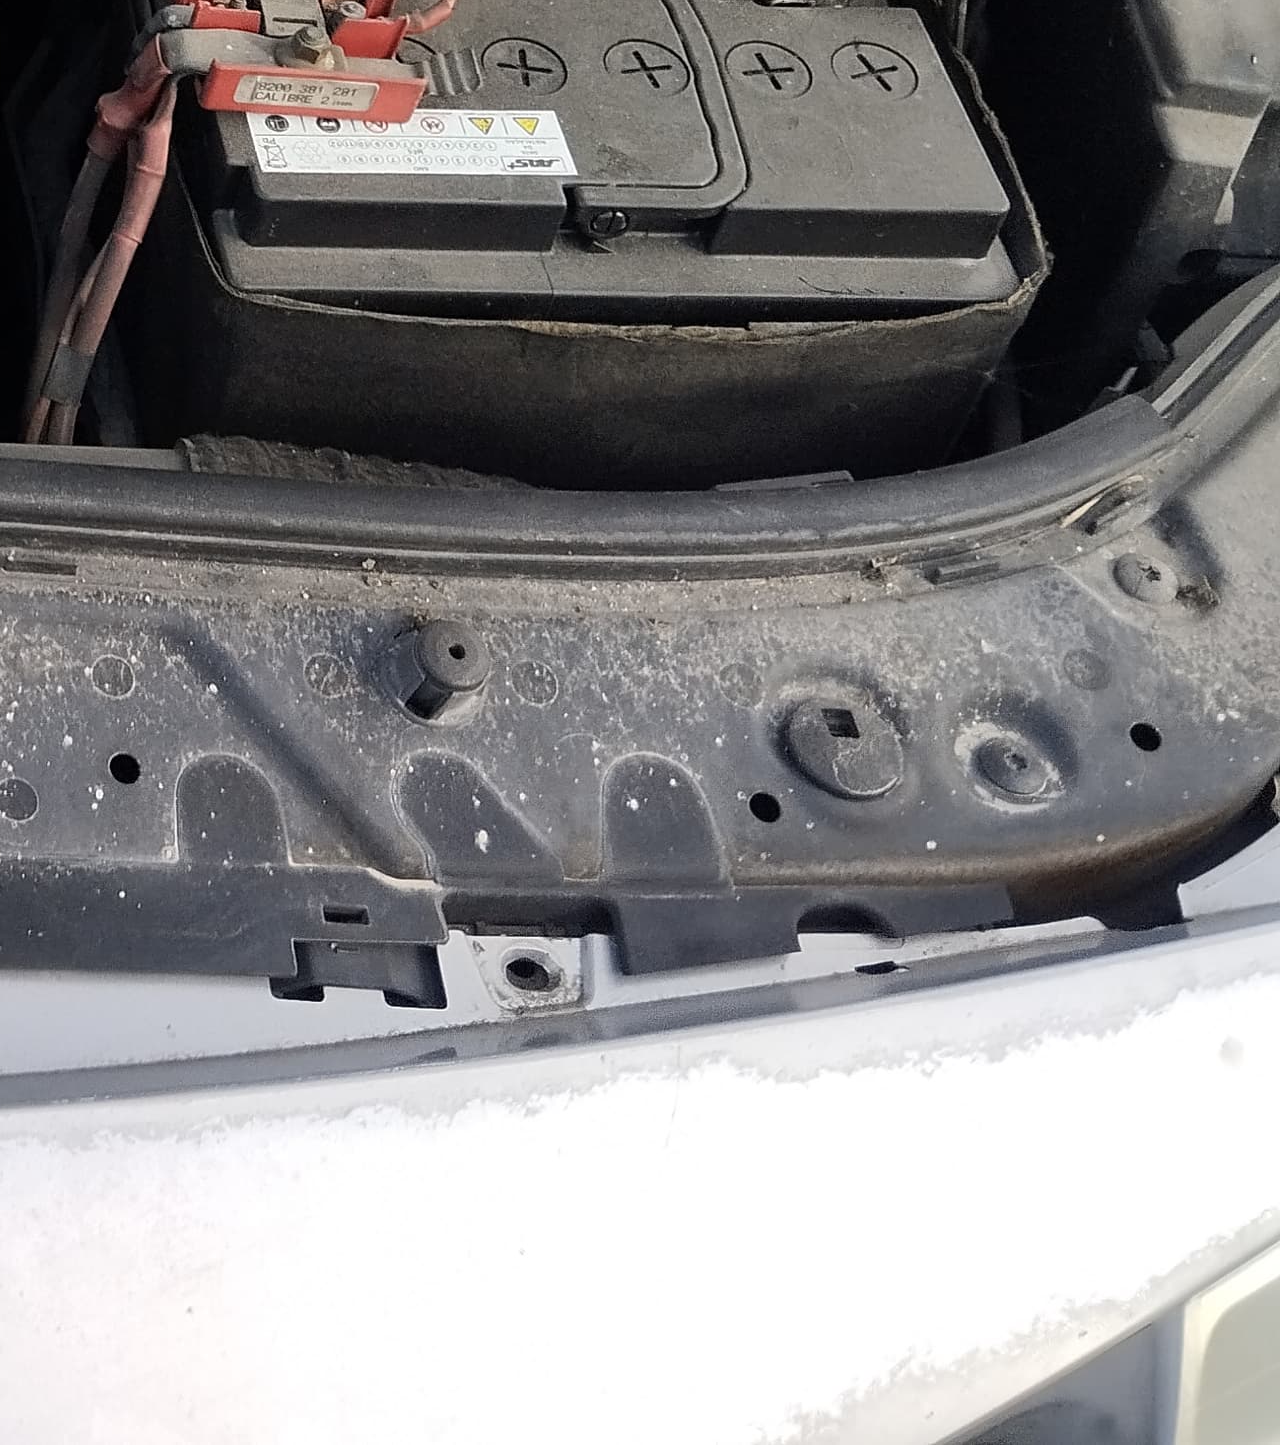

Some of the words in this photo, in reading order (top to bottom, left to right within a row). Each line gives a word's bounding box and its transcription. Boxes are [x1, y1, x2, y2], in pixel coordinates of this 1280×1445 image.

[258, 81, 292, 93] 8200
[299, 84, 323, 94] 381
[333, 87, 358, 97] 281
[254, 91, 313, 104] CALIBRE
[321, 96, 330, 105] 2
